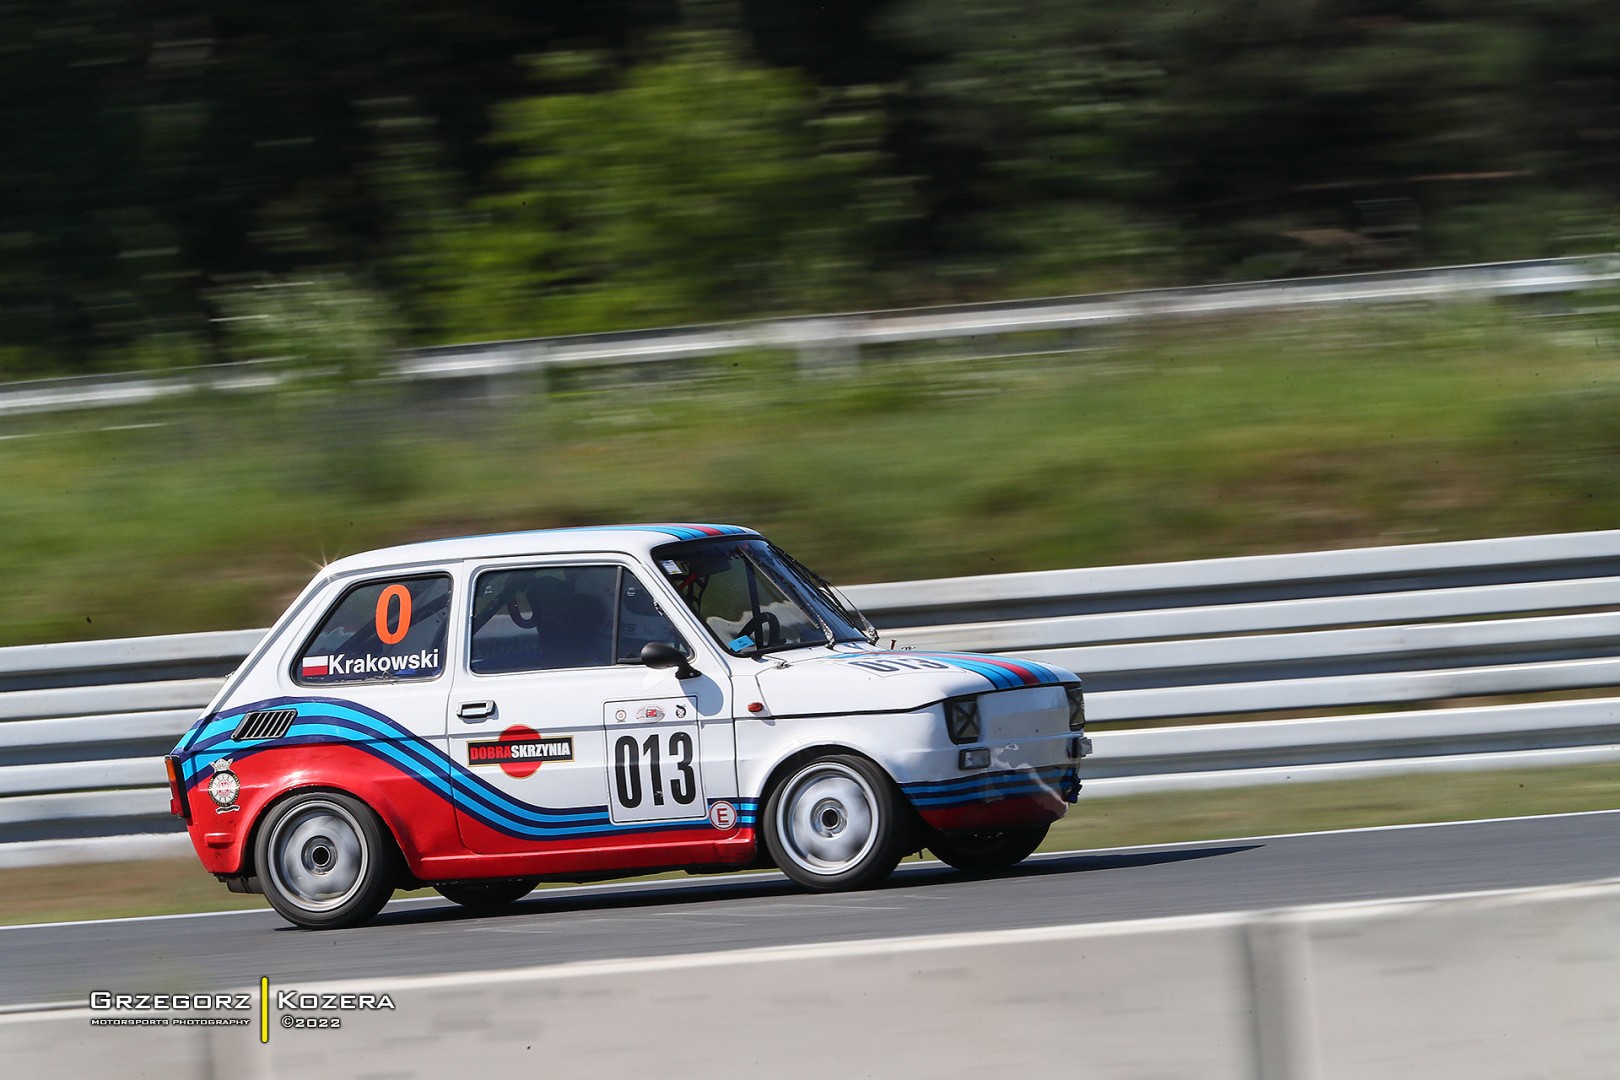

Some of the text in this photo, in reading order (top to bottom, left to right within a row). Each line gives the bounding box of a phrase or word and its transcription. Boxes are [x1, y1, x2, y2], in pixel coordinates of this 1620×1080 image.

[375, 584, 412, 645] 0
[328, 648, 439, 676] Krakowski
[615, 731, 697, 809] 013
[716, 807, 730, 823] E
